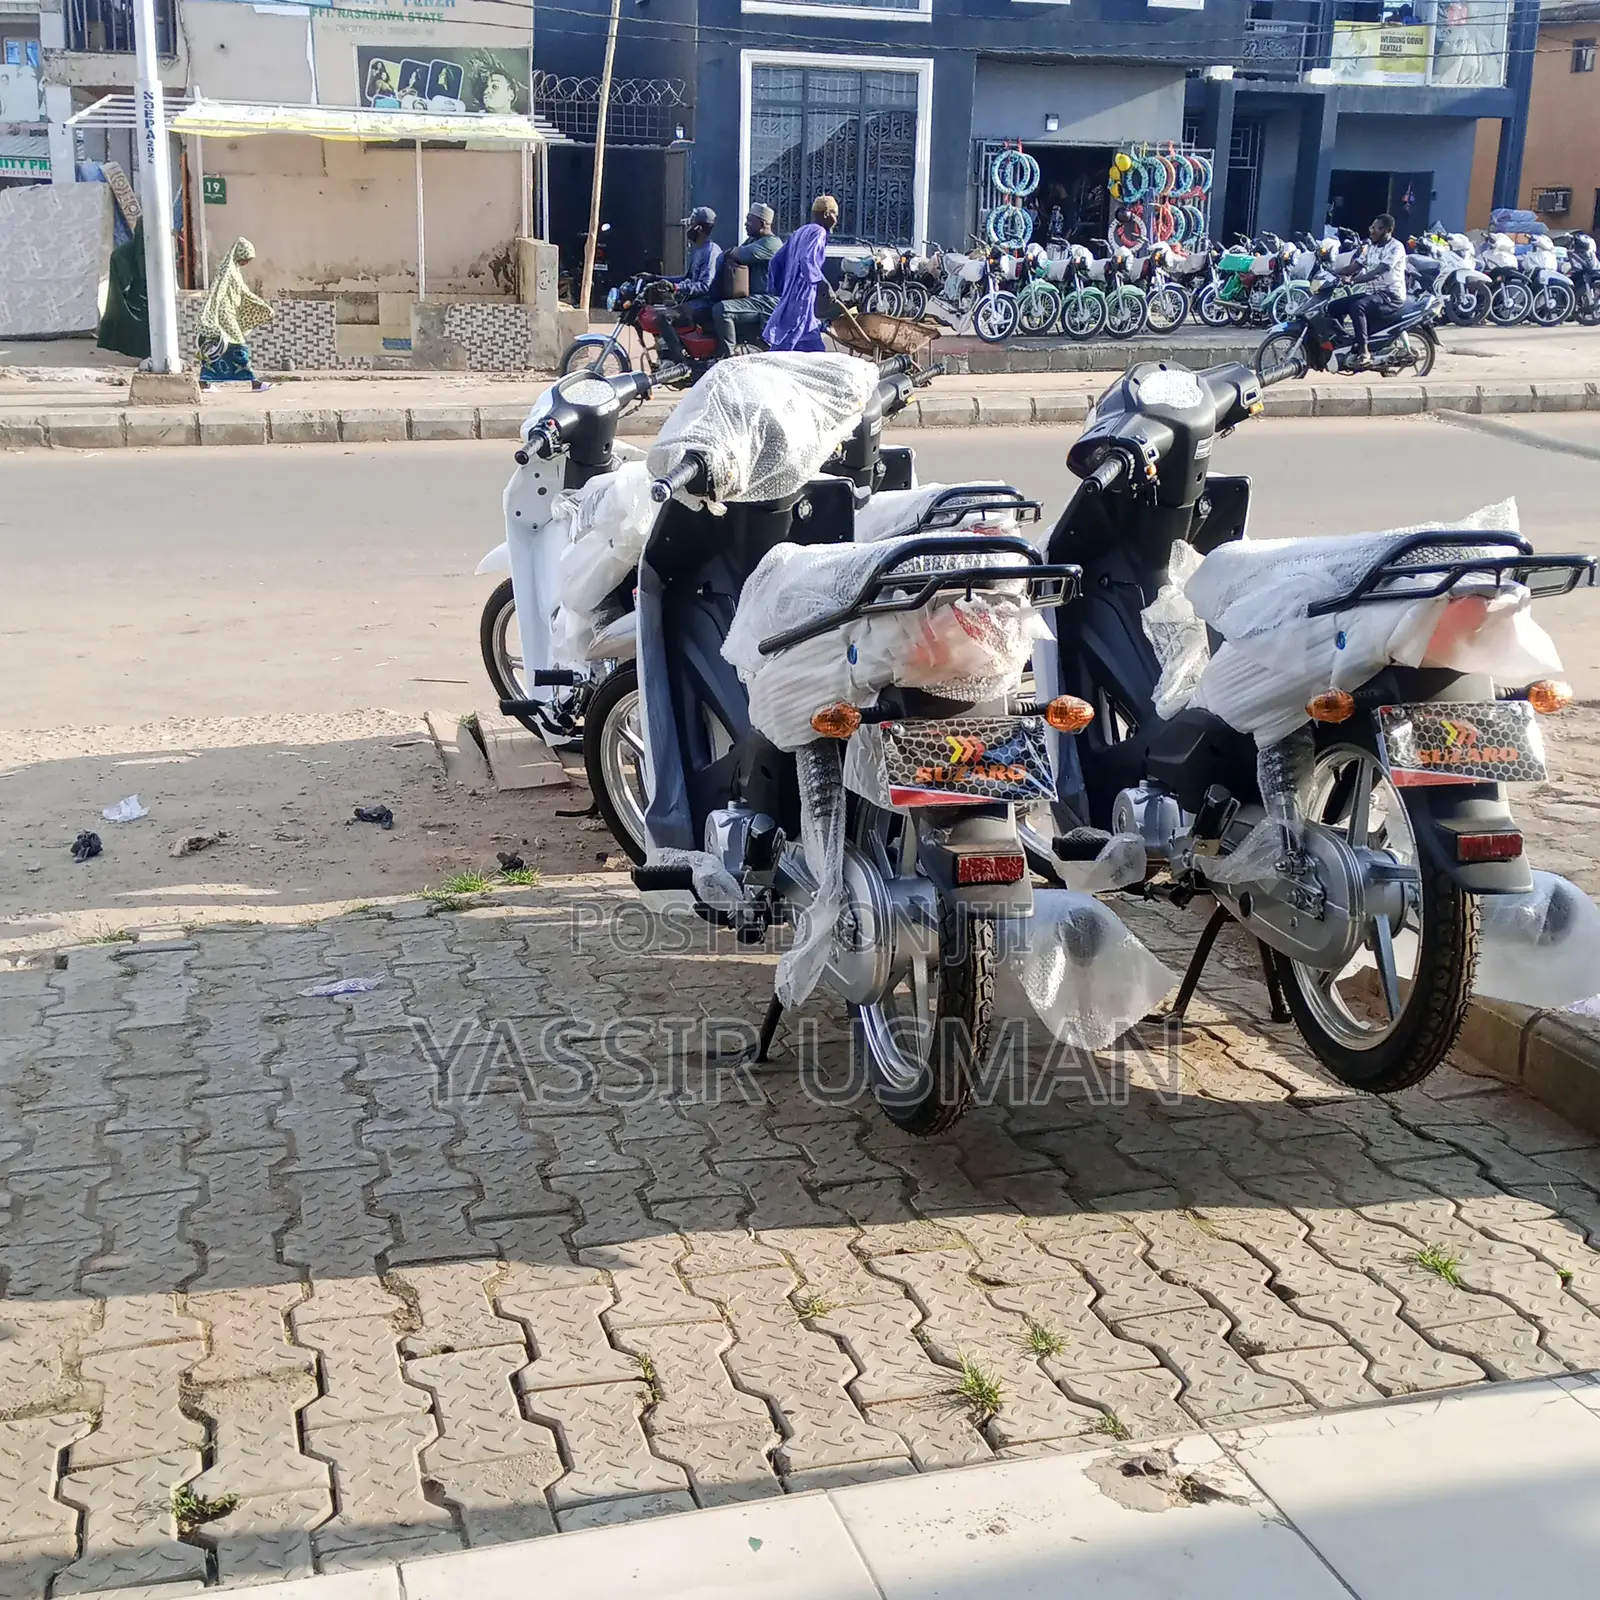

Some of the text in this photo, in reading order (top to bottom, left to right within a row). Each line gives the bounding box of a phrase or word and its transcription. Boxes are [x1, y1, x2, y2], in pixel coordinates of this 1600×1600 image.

[337, 8, 404, 21] NASARAWA
[407, 11, 445, 23] STATE
[1380, 35, 1424, 46] WEDDING GOWN
[1379, 44, 1403, 53] RENTALS
[206, 181, 220, 193] 19
